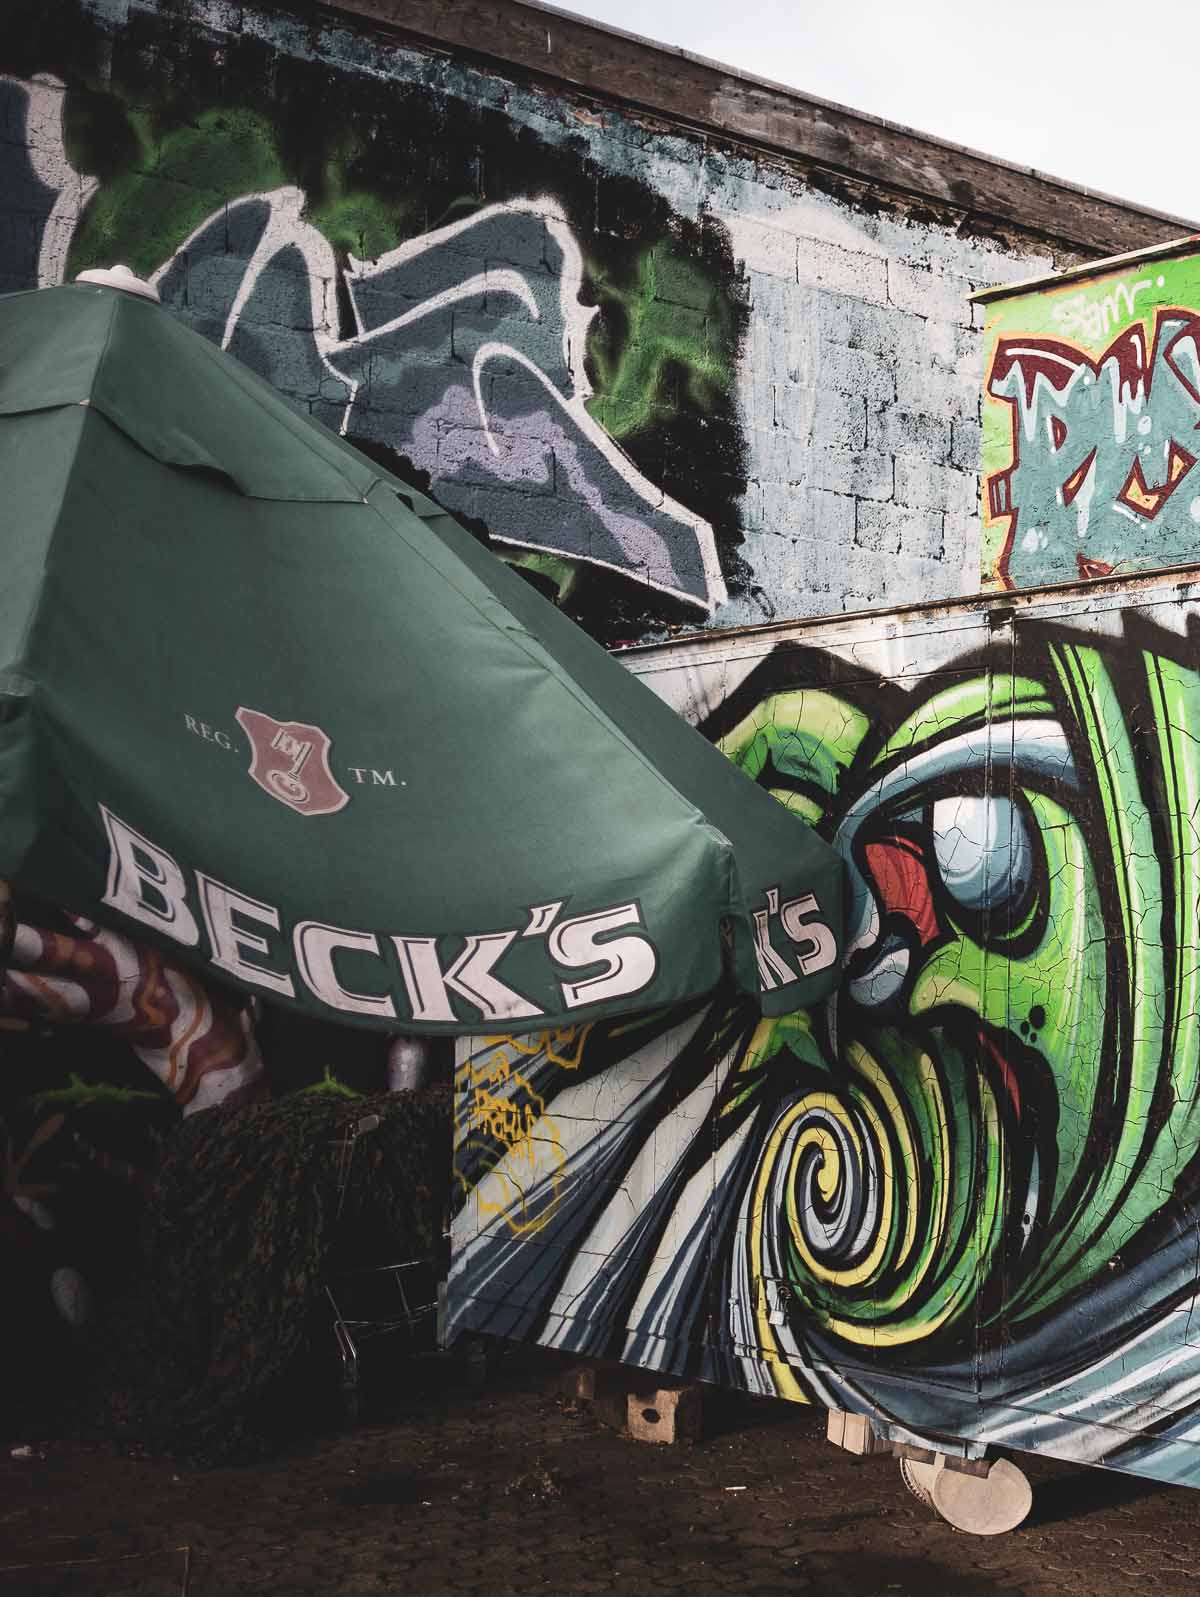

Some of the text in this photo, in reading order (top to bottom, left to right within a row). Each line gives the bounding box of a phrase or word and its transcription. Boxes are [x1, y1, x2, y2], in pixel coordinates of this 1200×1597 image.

[184, 713, 239, 752] REG.
[347, 767, 408, 787] TM.
[99, 803, 656, 1021] BECK'S
